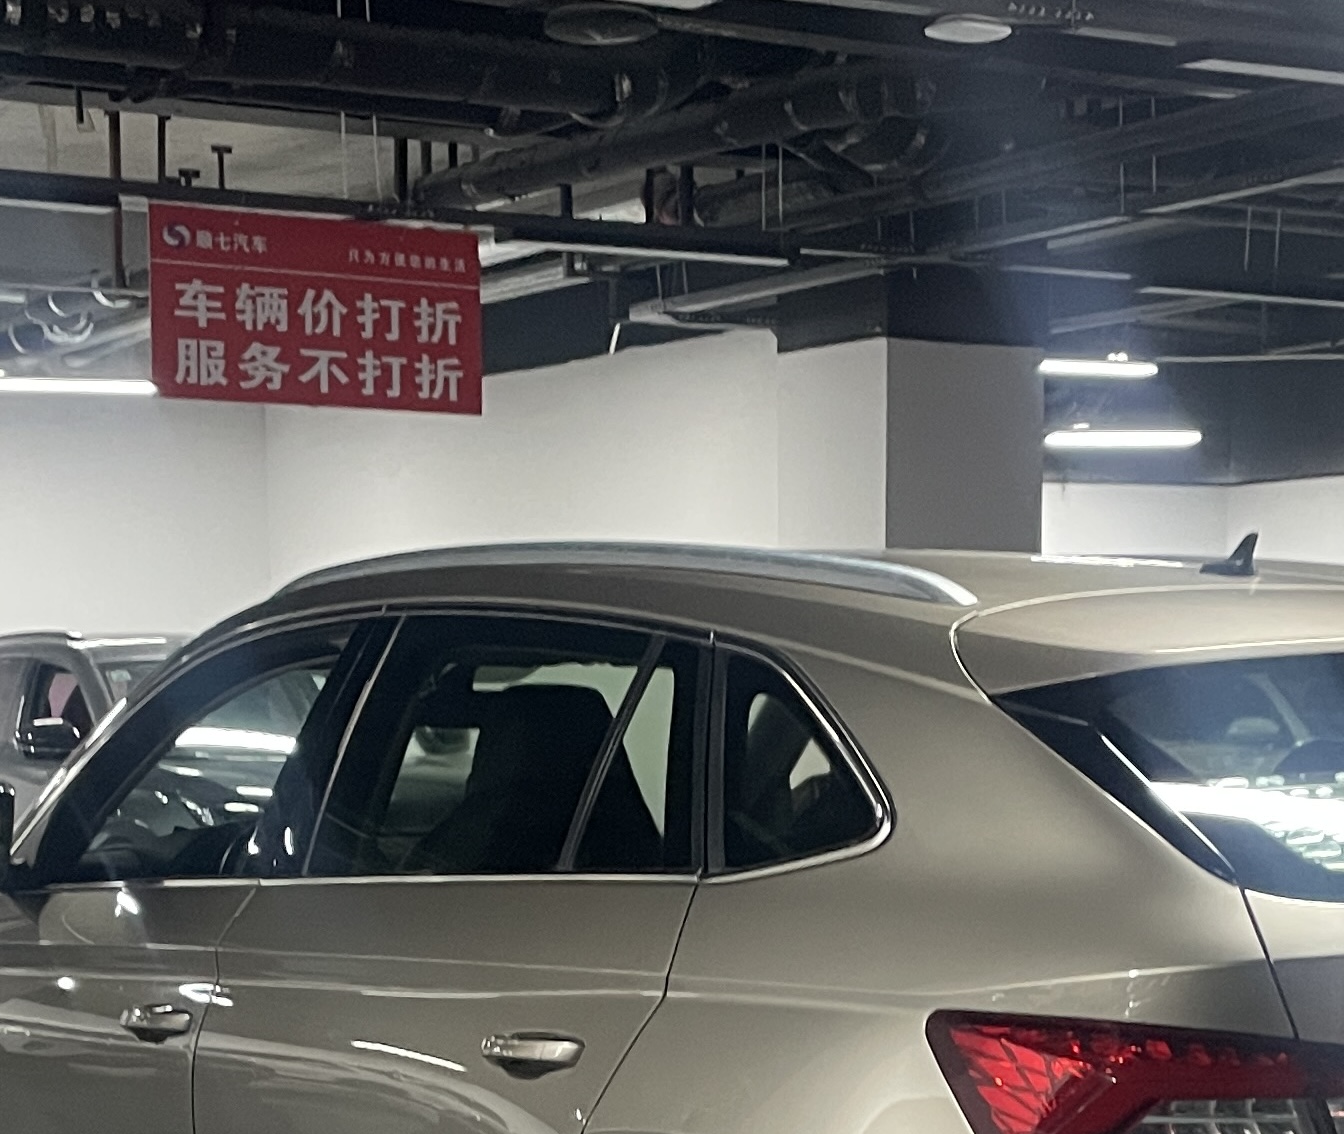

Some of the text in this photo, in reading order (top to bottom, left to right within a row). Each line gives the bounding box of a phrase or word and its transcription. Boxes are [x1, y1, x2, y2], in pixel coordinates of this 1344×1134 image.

[174, 278, 462, 346] 车辆价打折
[174, 337, 464, 401] 服务不打折
